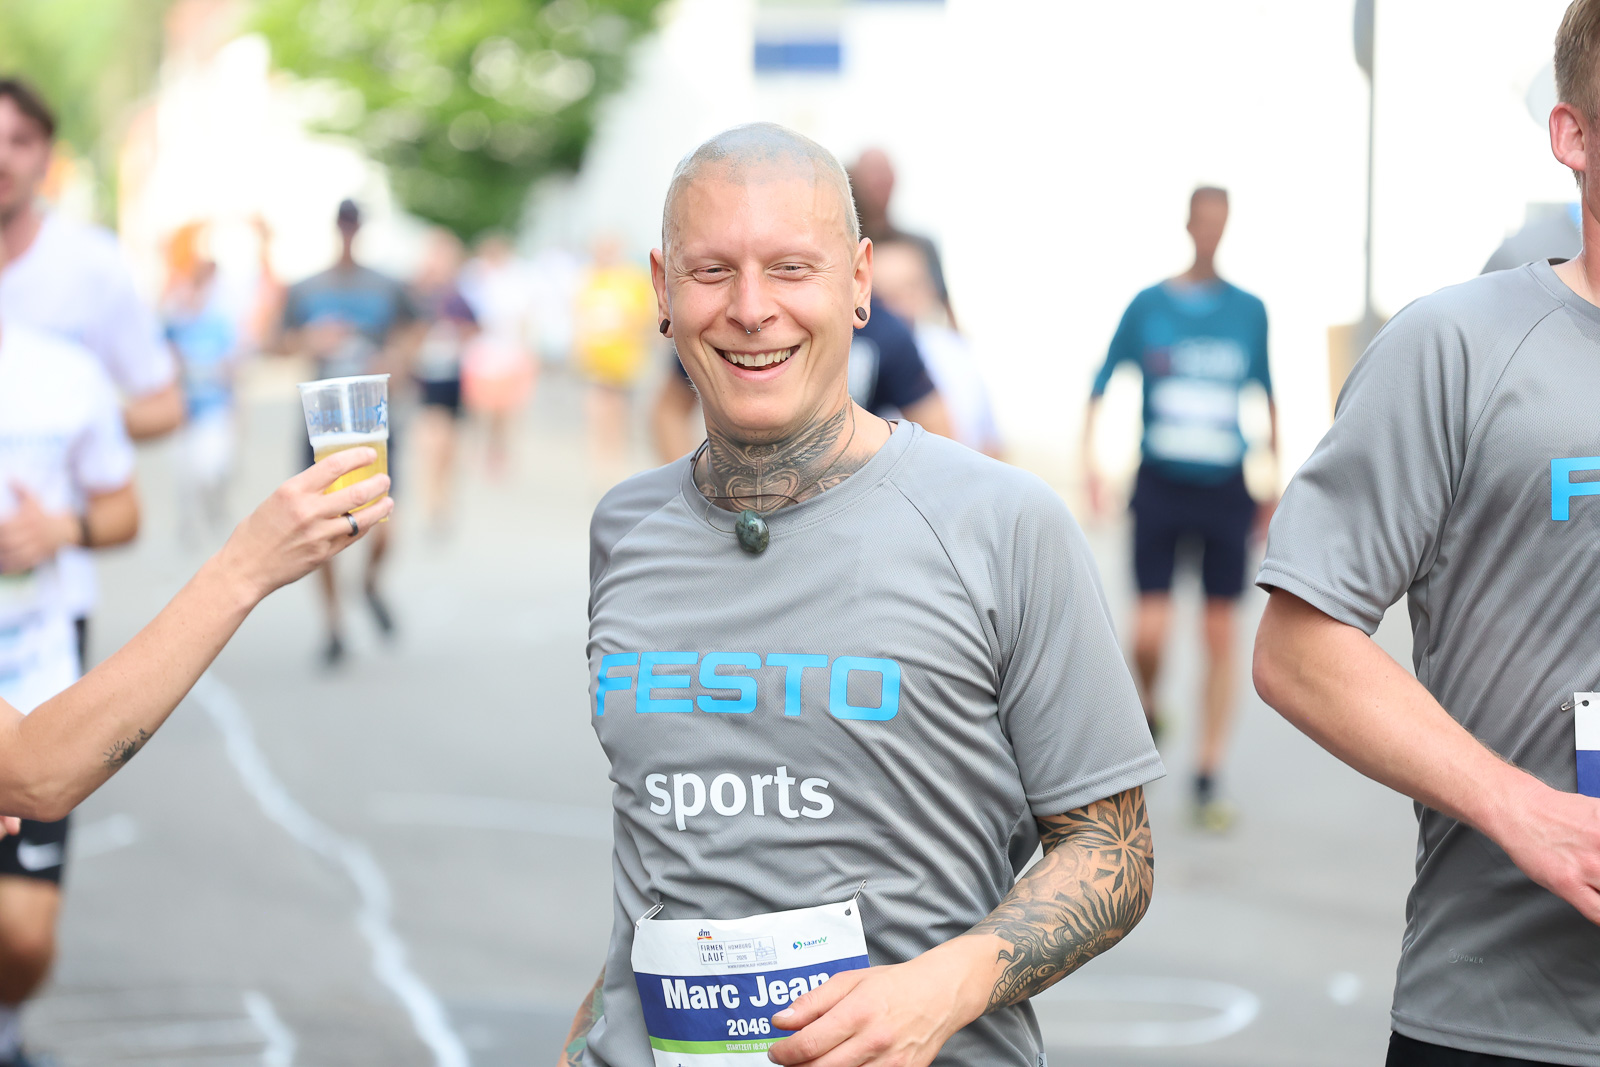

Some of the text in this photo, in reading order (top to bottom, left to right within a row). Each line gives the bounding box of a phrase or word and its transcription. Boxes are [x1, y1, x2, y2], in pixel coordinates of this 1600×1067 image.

[596, 651, 901, 721] FESTO
[645, 765, 835, 831] sports
[700, 944, 724, 952] FIRMEN
[701, 952, 725, 962] LAUF
[661, 978, 740, 1009] Marc
[726, 1016, 771, 1036] 2046
[726, 1043, 751, 1051] STARTZEIT
